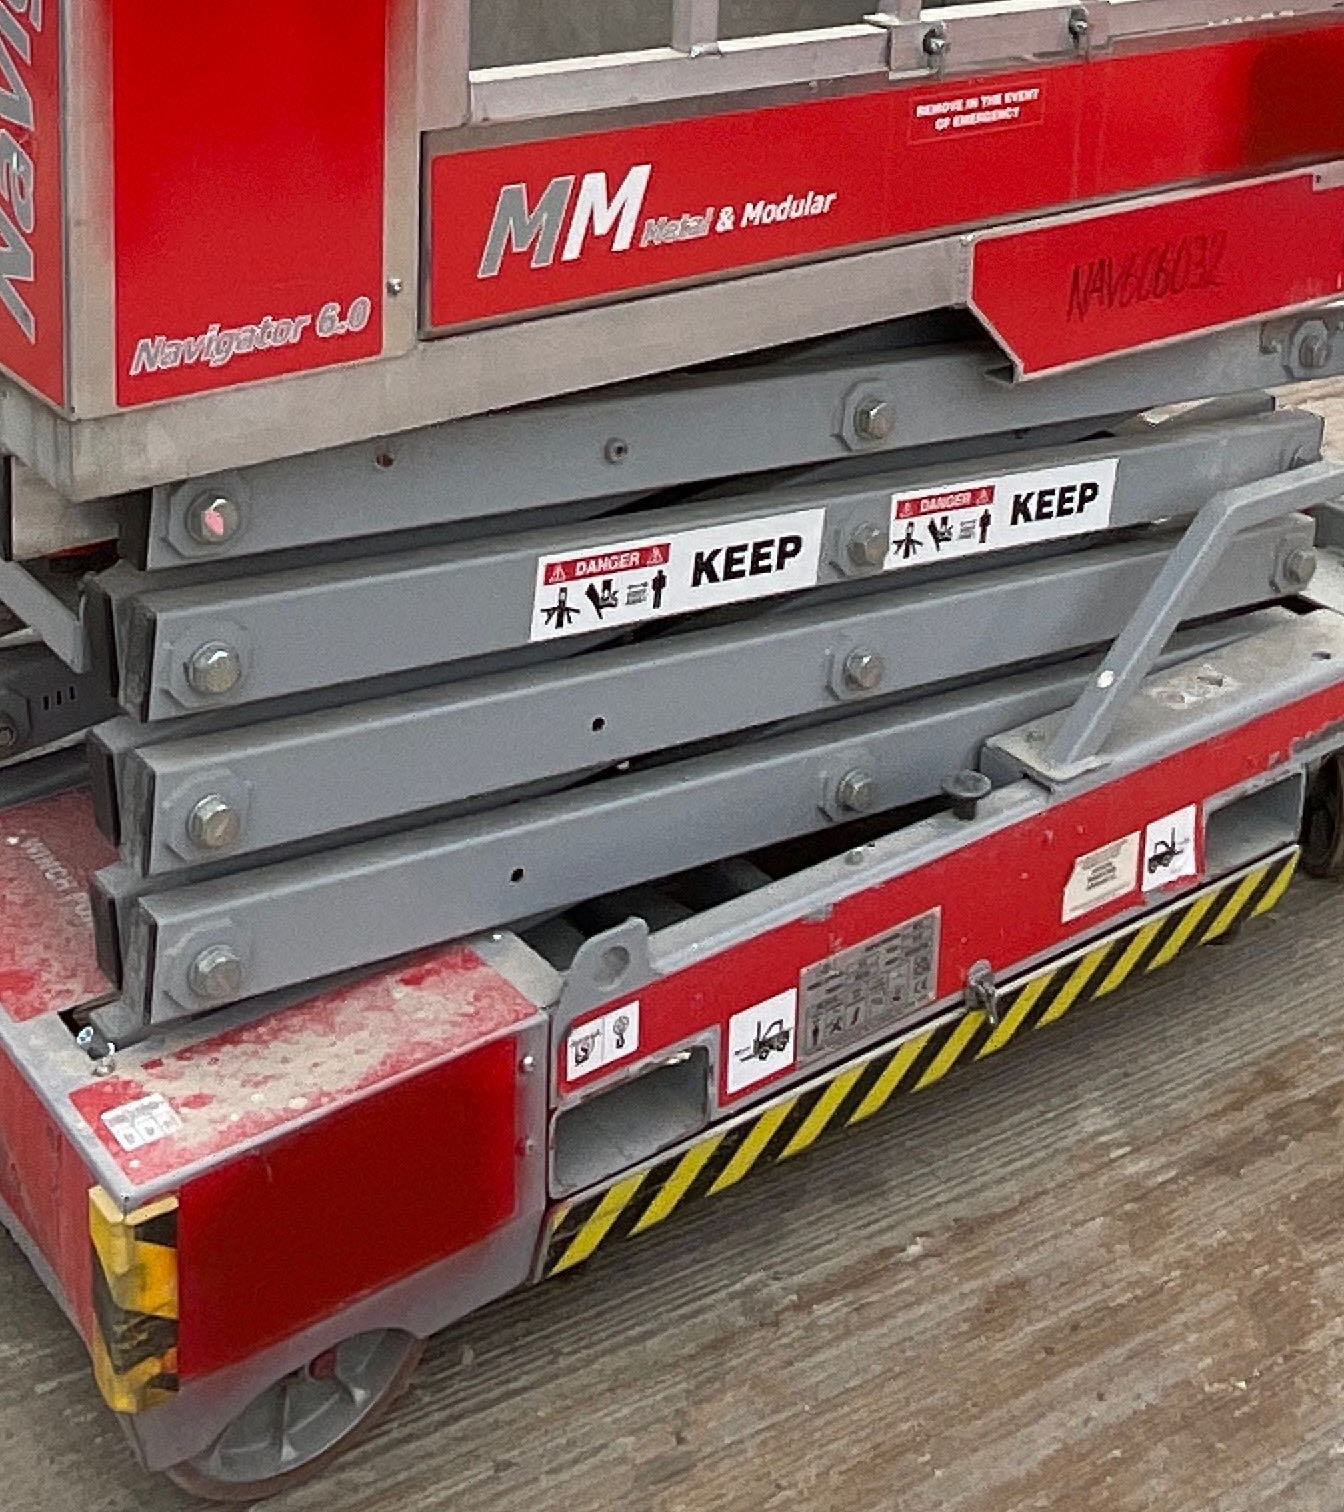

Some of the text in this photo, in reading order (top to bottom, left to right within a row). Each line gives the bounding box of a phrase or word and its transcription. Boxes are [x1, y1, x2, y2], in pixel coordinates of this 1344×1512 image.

[477, 163, 838, 279] MM Metal & Modular
[129, 295, 372, 377] Navigator 6.0
[919, 481, 1100, 526] DANGER KEEP
[575, 533, 804, 588] DANGER KEEP
